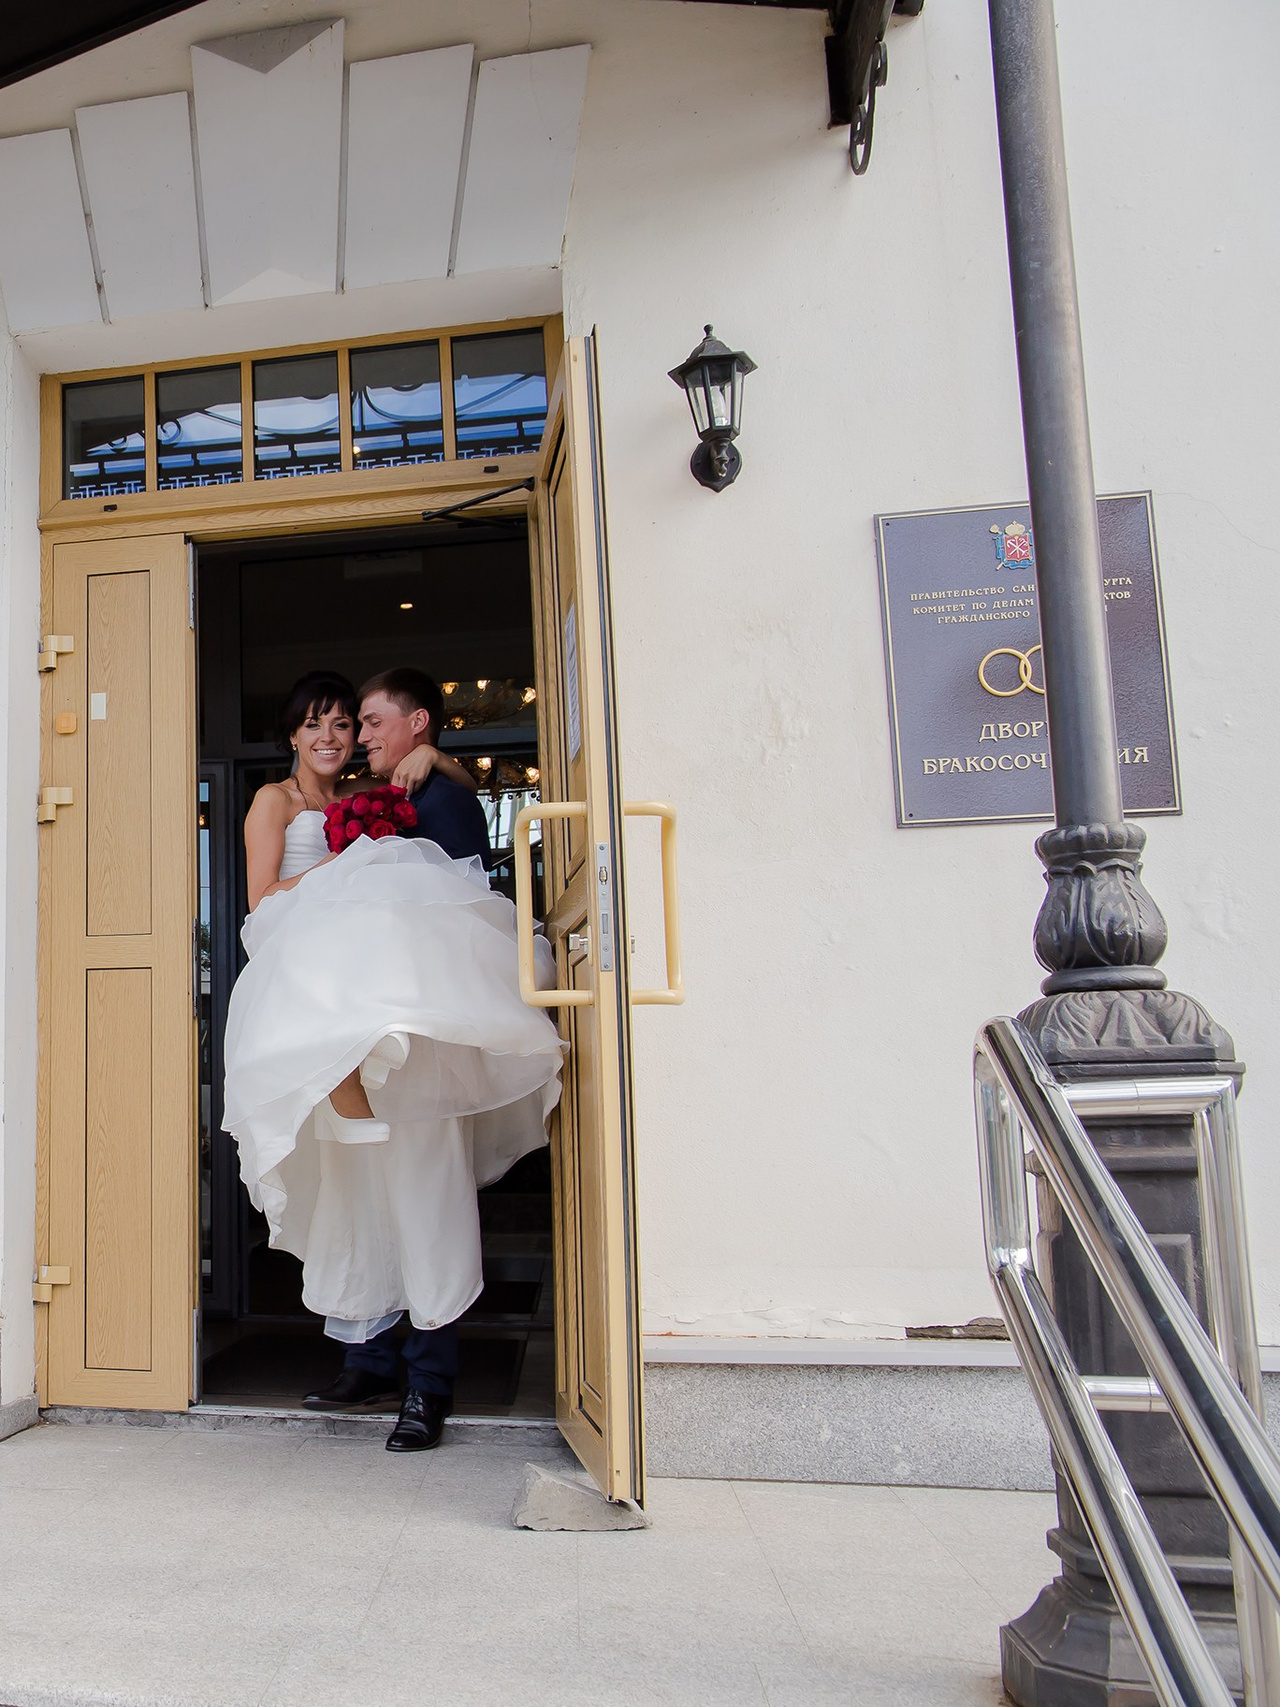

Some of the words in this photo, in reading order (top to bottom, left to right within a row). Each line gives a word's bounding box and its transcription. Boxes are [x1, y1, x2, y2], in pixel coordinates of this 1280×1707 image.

[910, 586, 1005, 601] ПРАВИТЕЛЬСТВО
[913, 603, 966, 614] КОМИТЕТ
[972, 602, 987, 610] ПО
[993, 598, 1035, 609] ДЕЛАМ
[938, 610, 1030, 624] ГРАЖДАНСКОГО
[979, 720, 1049, 742] ДВОР
